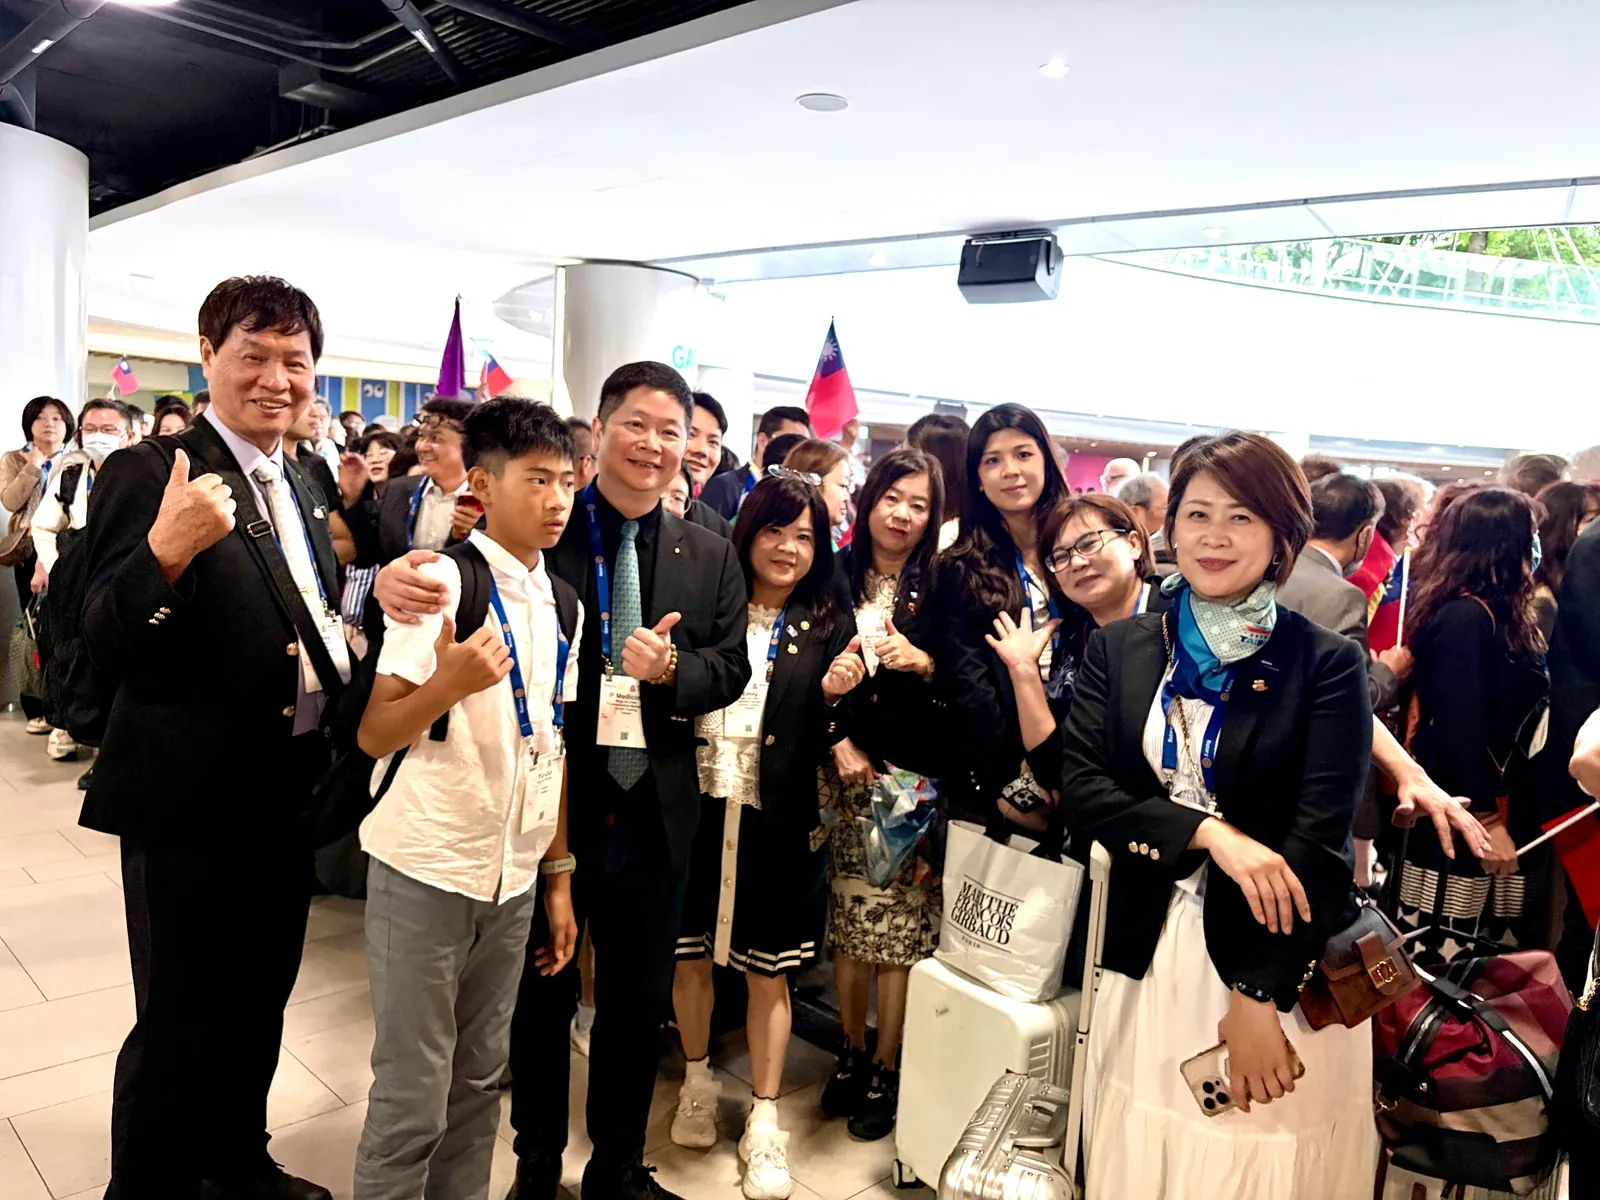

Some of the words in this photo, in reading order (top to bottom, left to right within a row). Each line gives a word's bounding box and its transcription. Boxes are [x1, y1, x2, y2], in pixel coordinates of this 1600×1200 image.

[672, 345, 696, 369] GA
[1240, 635, 1267, 646] TAIP
[951, 905, 1010, 945] GIRBAUD
